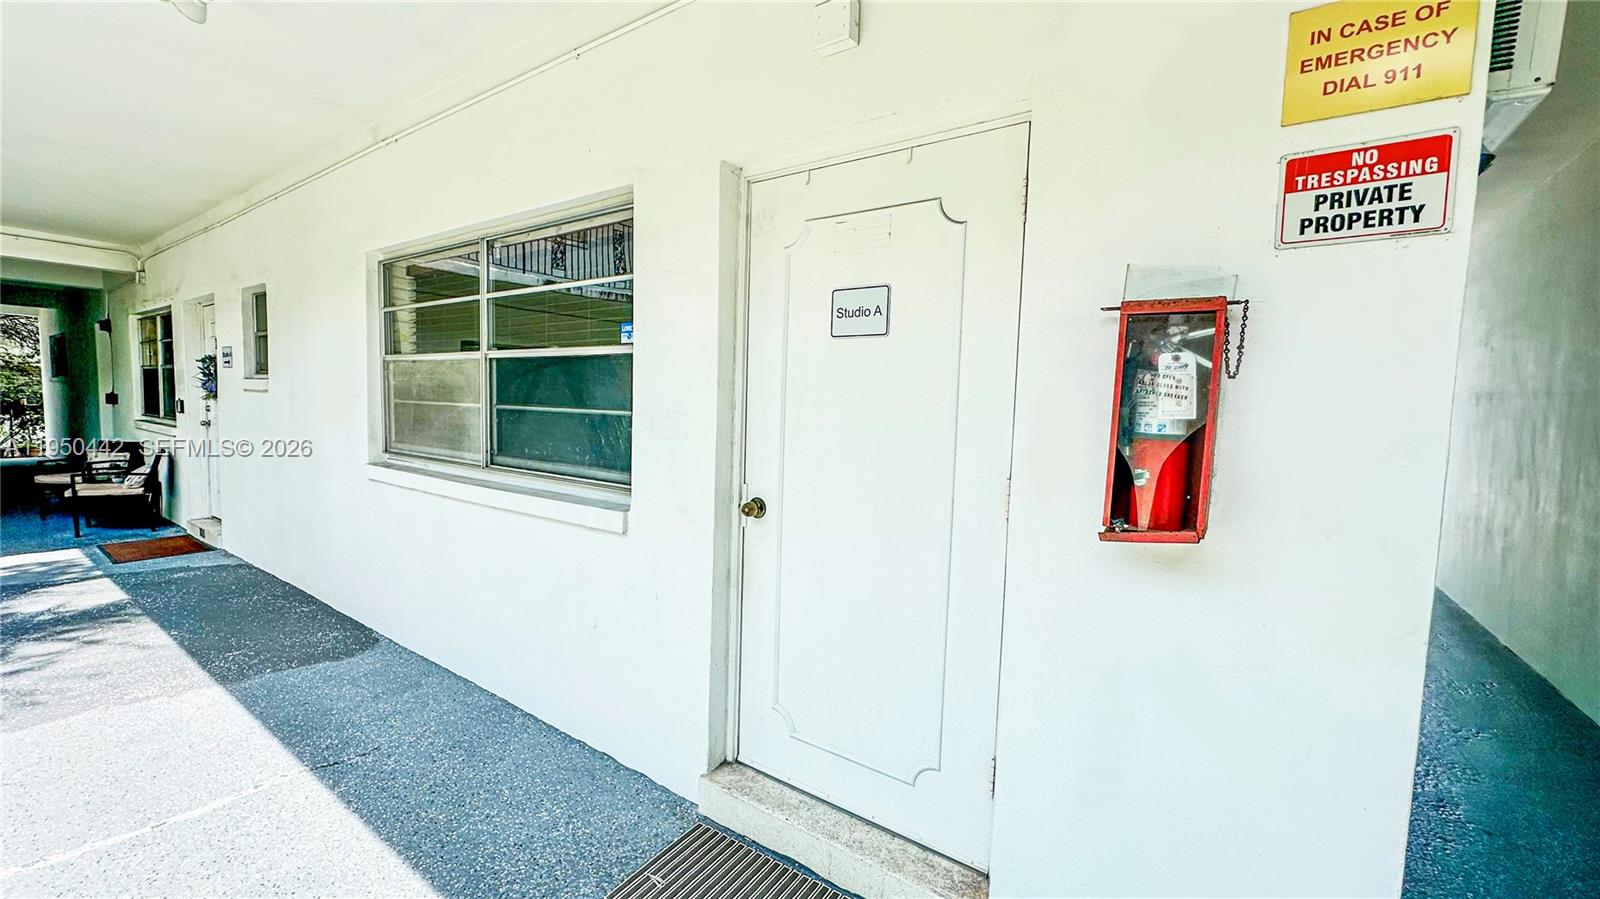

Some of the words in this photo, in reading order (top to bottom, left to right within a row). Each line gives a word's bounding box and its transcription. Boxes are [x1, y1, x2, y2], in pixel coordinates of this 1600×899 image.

[1310, 27, 1332, 45] IN
[1339, 10, 1407, 38] CASE
[1415, 0, 1451, 22] OF
[1300, 27, 1459, 74] EMERGENCY
[1322, 74, 1377, 96] DIAL
[1384, 63, 1423, 85] 911
[1295, 156, 1439, 191] TRESPASSING
[1351, 149, 1379, 167] NO
[1313, 182, 1413, 212] PRIVATE
[1299, 203, 1426, 236] PROPERTY
[836, 305, 871, 319] Studio
[873, 304, 883, 317] A
